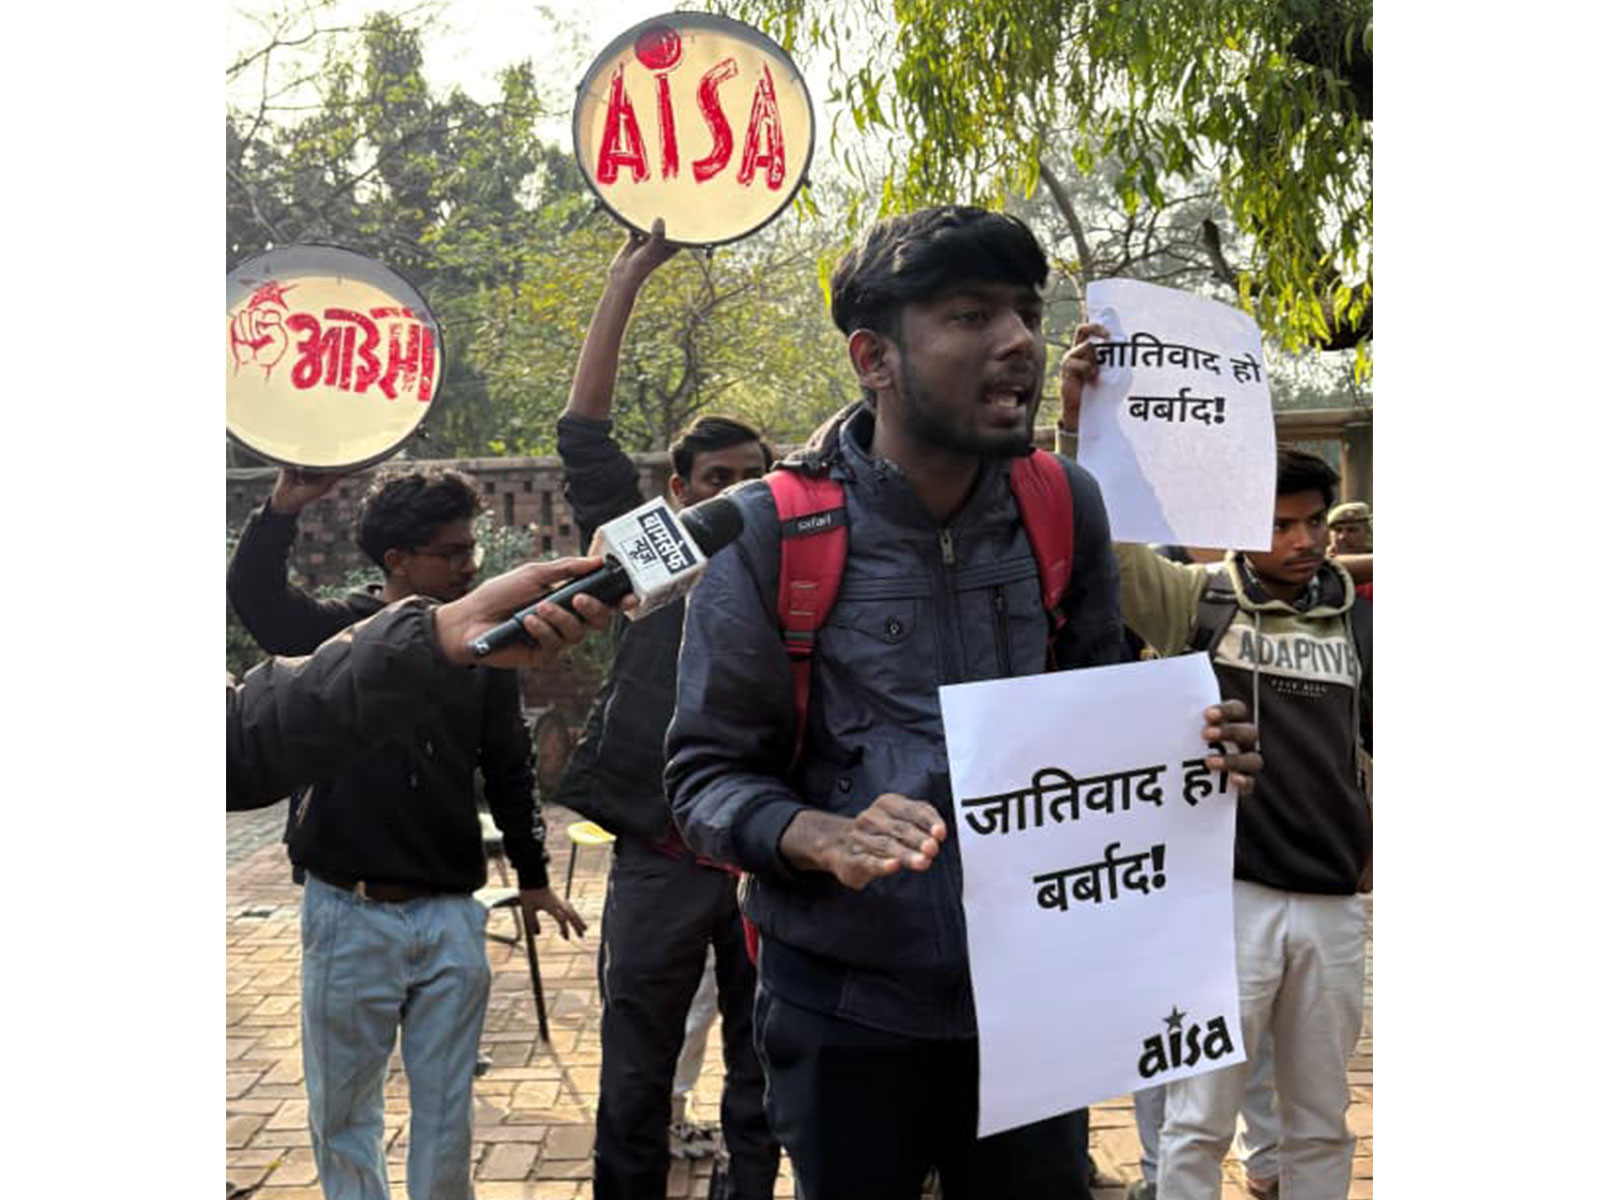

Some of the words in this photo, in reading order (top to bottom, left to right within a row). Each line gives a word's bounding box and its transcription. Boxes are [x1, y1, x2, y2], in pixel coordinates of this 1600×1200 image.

[597, 24, 785, 190] AISA
[1092, 332, 1221, 375] जातिवाद
[1230, 353, 1261, 383] हो
[1128, 388, 1226, 424] बर्बाद!
[961, 766, 1167, 835] जातिवाद
[1033, 842, 1166, 911] बर्बाद!
[1138, 1005, 1234, 1078] aisa
